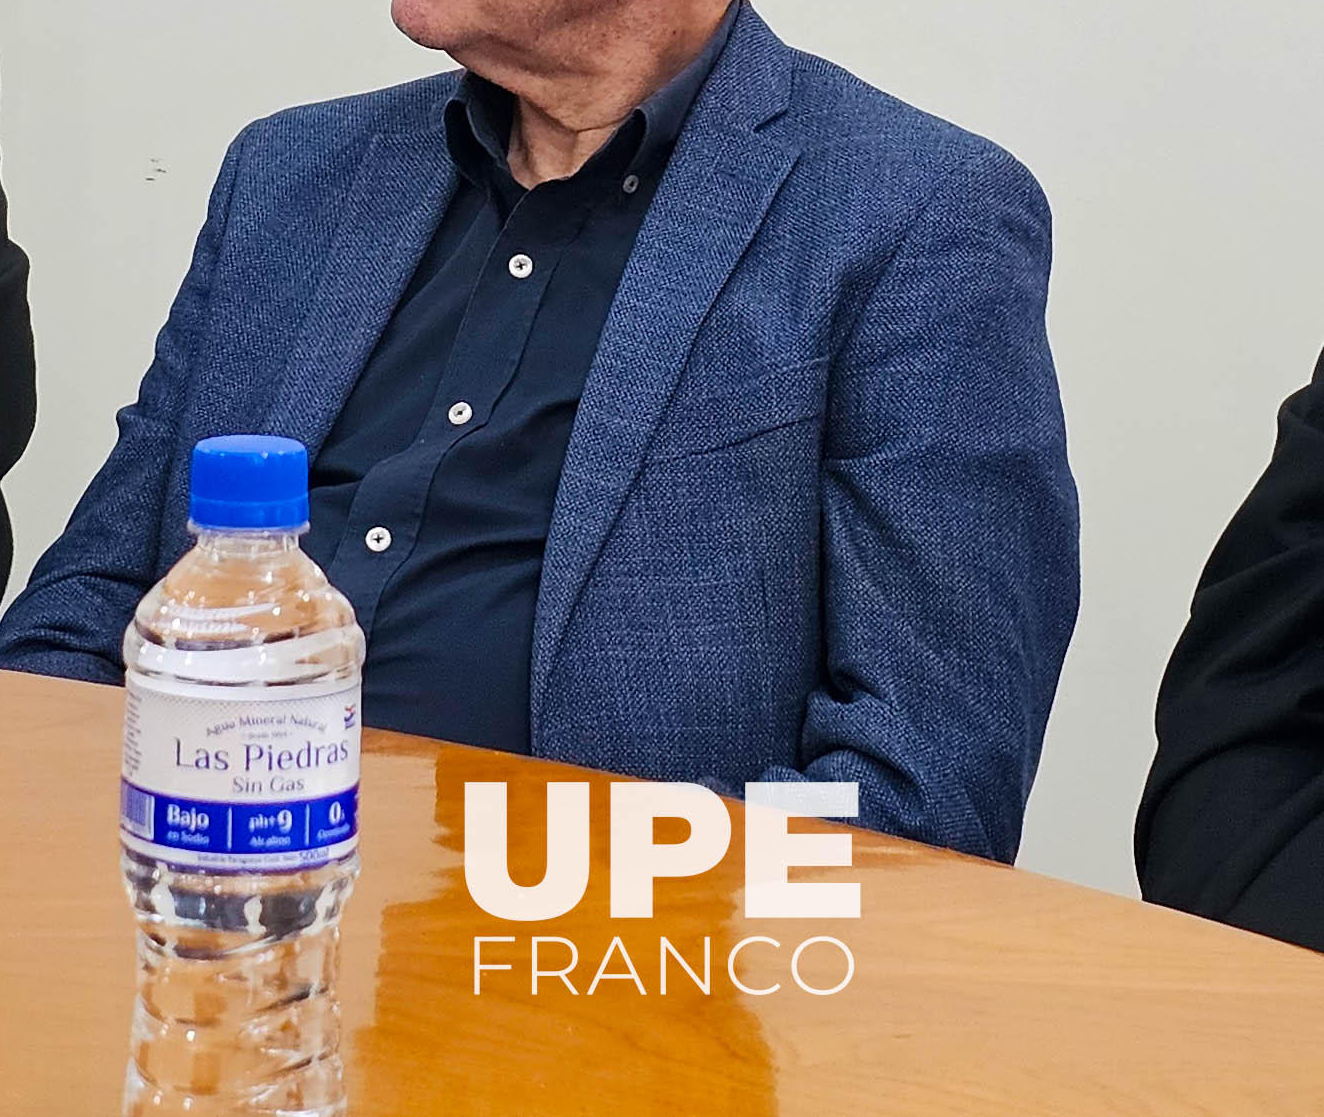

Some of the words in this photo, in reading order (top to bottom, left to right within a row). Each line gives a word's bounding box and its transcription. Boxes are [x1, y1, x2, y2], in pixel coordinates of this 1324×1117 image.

[238, 713, 287, 728] Mineral
[290, 714, 328, 734] Natural
[175, 737, 229, 771] Las
[244, 738, 349, 772] Piedras
[232, 775, 263, 794] Sin
[269, 776, 305, 794] Gas
[166, 803, 210, 833] Bajo
